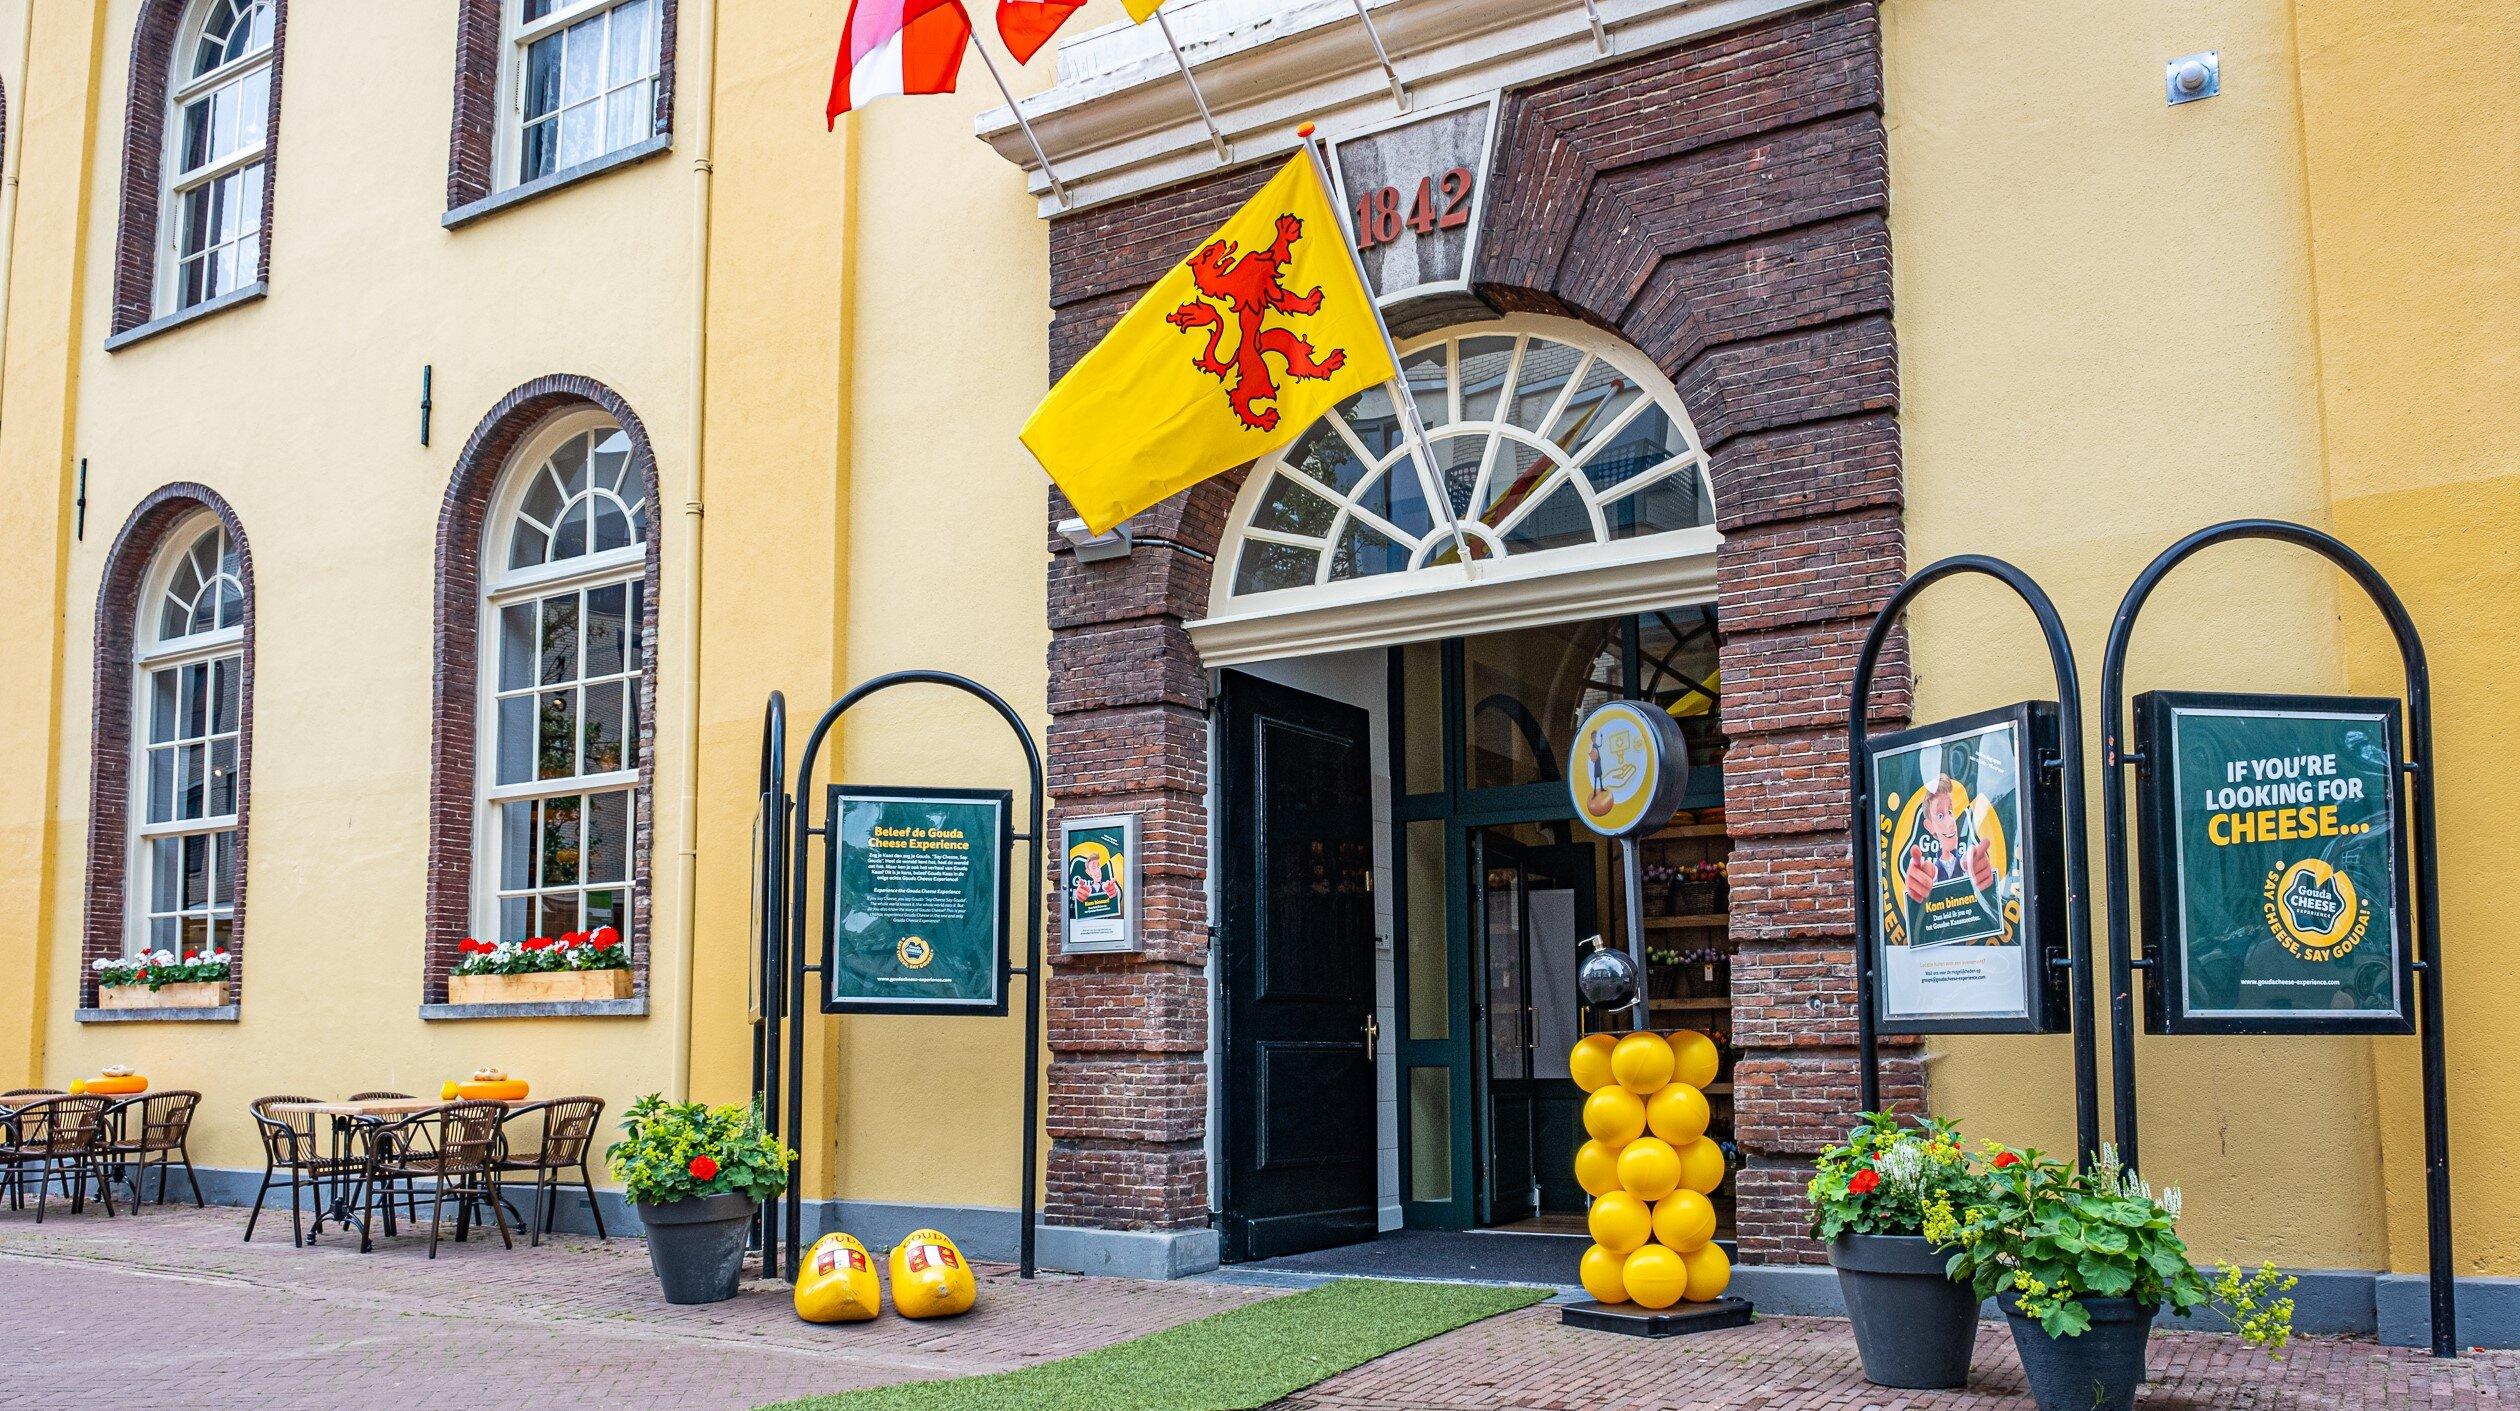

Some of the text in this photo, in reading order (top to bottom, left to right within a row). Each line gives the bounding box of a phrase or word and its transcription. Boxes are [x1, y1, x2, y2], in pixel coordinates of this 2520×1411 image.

[1356, 167, 1472, 250] 1842
[2227, 754, 2337, 783] IF YOU'RE
[2206, 777, 2365, 811] LOOKING FOR
[875, 826, 963, 838] Beleef de Gouda
[2208, 805, 2370, 846] CHEESE...
[867, 837, 969, 851] Cheese Experience
[1919, 834, 1967, 855] Goa
[2298, 885, 2332, 900] Gouda
[1925, 902, 1945, 913] Kom
[2291, 895, 2337, 913] CHEESE
[2264, 871, 2371, 961] SAY CHEESE, SAY GOUDA!
[2296, 909, 2331, 919] EXPERIENCE
